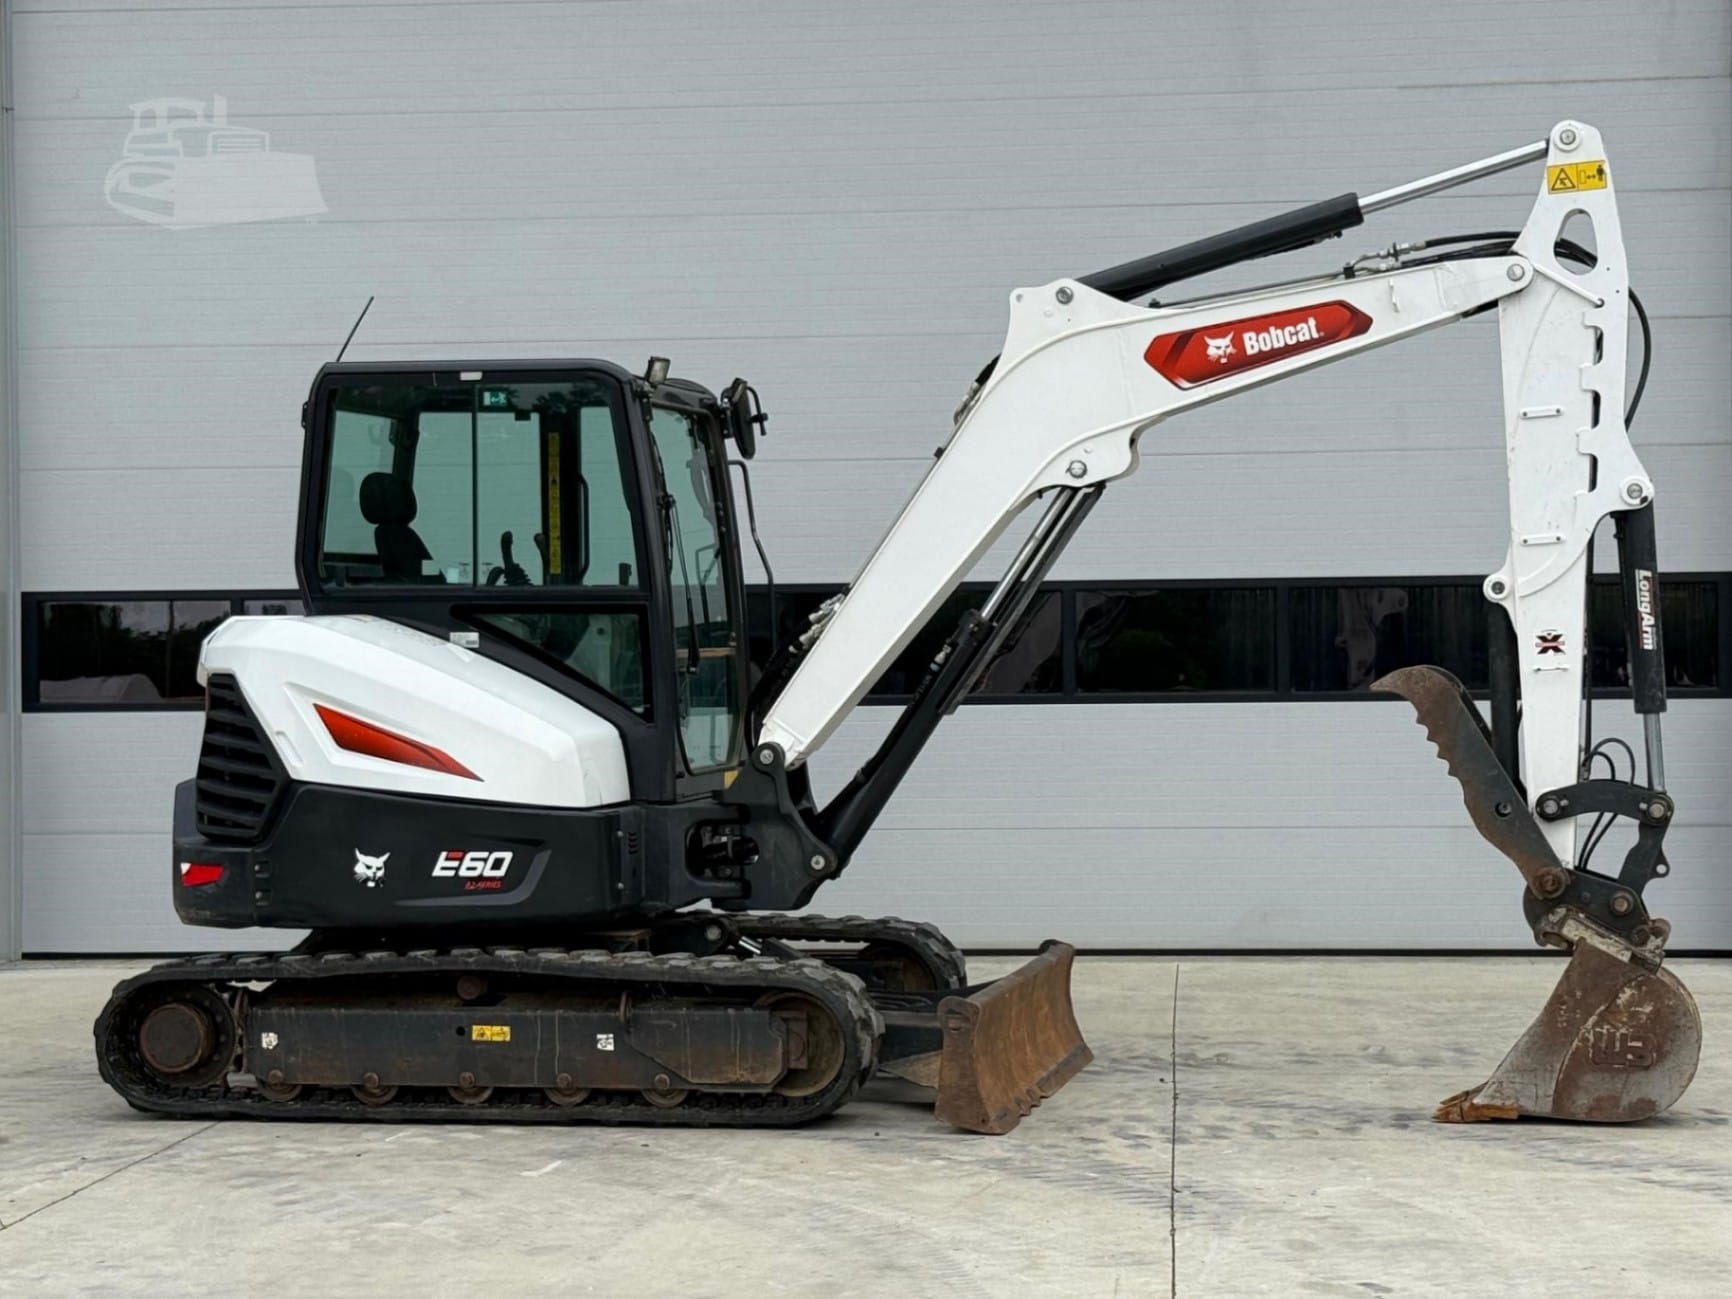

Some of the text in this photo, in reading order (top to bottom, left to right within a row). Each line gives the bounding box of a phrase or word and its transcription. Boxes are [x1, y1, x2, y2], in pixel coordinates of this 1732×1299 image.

[1242, 316, 1319, 356] Bobcat
[1635, 568, 1657, 651] LongArm
[431, 851, 514, 877] E60
